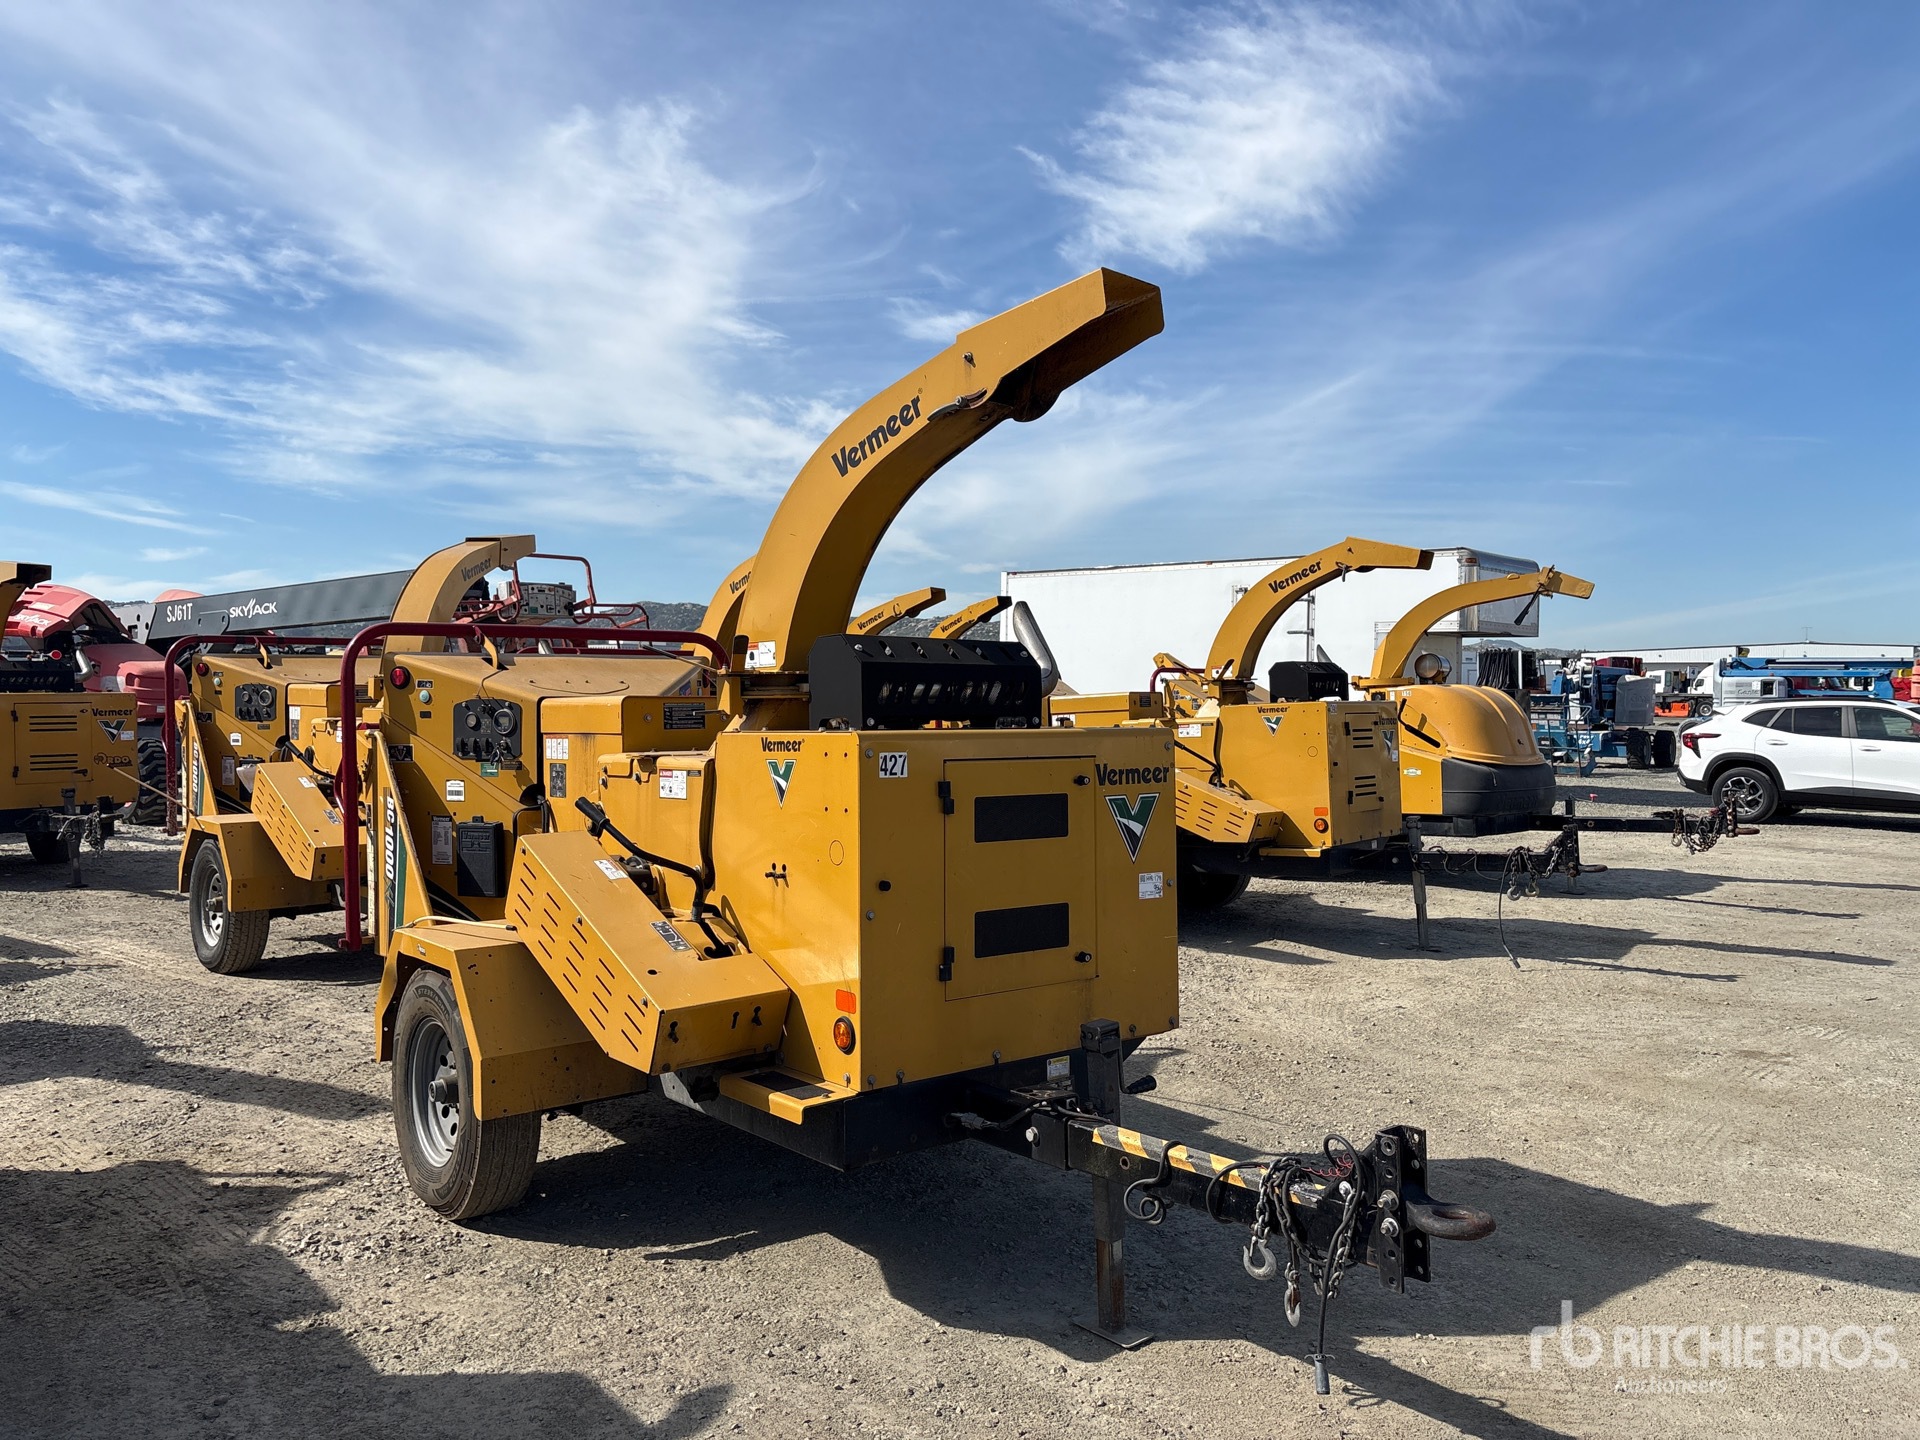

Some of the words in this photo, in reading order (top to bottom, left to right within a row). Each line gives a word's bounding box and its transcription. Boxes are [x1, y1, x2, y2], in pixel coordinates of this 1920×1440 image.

[831, 395, 921, 477] Vermeer
[461, 558, 491, 581] Vermeer
[1268, 561, 1322, 593] Vermeer
[167, 603, 193, 622] SJ61T
[229, 598, 277, 618] SKYJACK
[857, 611, 884, 630] Vermeer
[91, 708, 133, 716] Vermeer
[761, 737, 802, 752] Vermeer
[880, 754, 906, 776] 427
[1095, 764, 1169, 786] Vermeer
